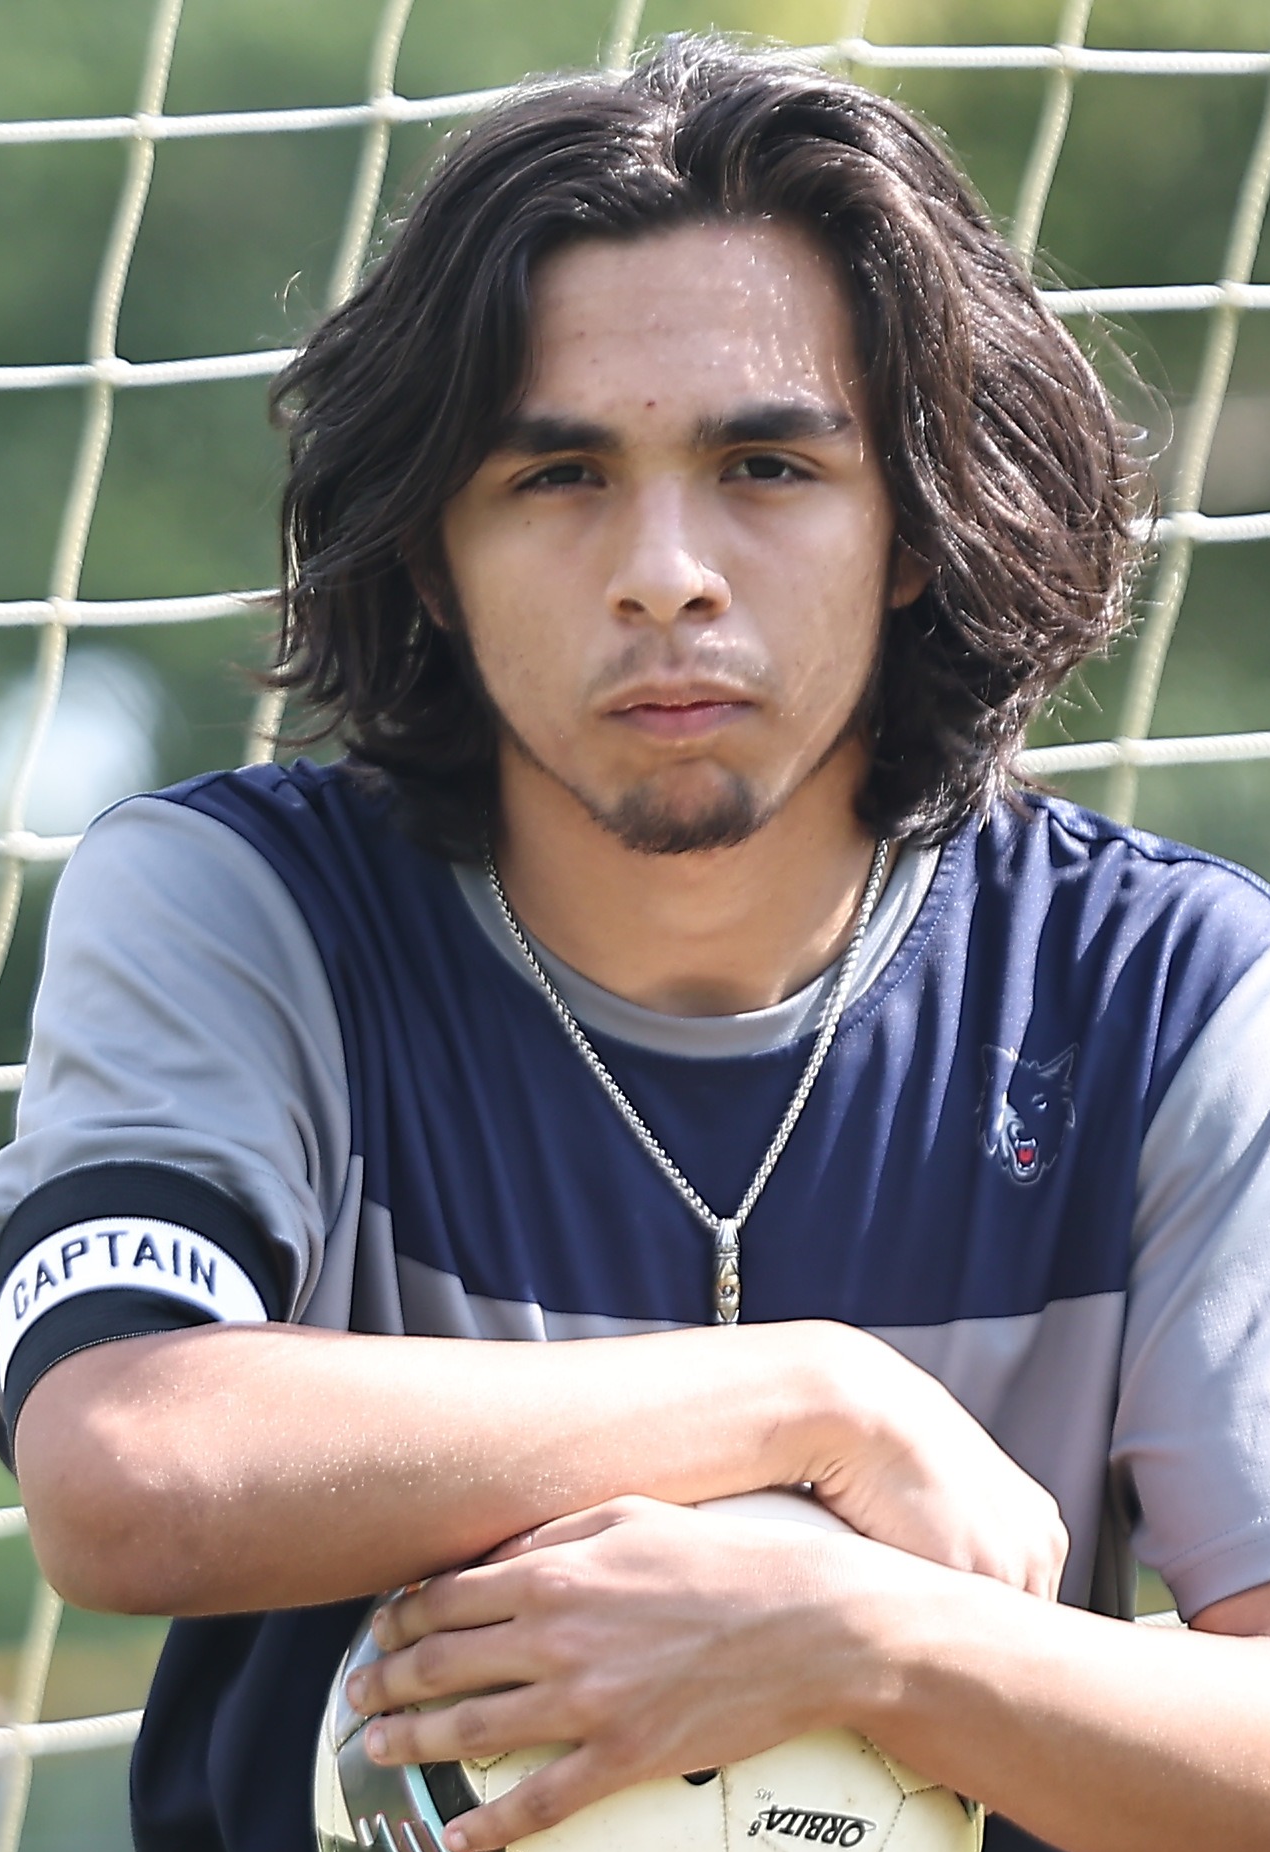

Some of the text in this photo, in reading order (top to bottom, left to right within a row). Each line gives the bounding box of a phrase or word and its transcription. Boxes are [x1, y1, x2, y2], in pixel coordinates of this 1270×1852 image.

[13, 1230, 217, 1320] CAPTAIN
[755, 1787, 775, 1801] MS
[763, 1805, 867, 1847] ORBITA
